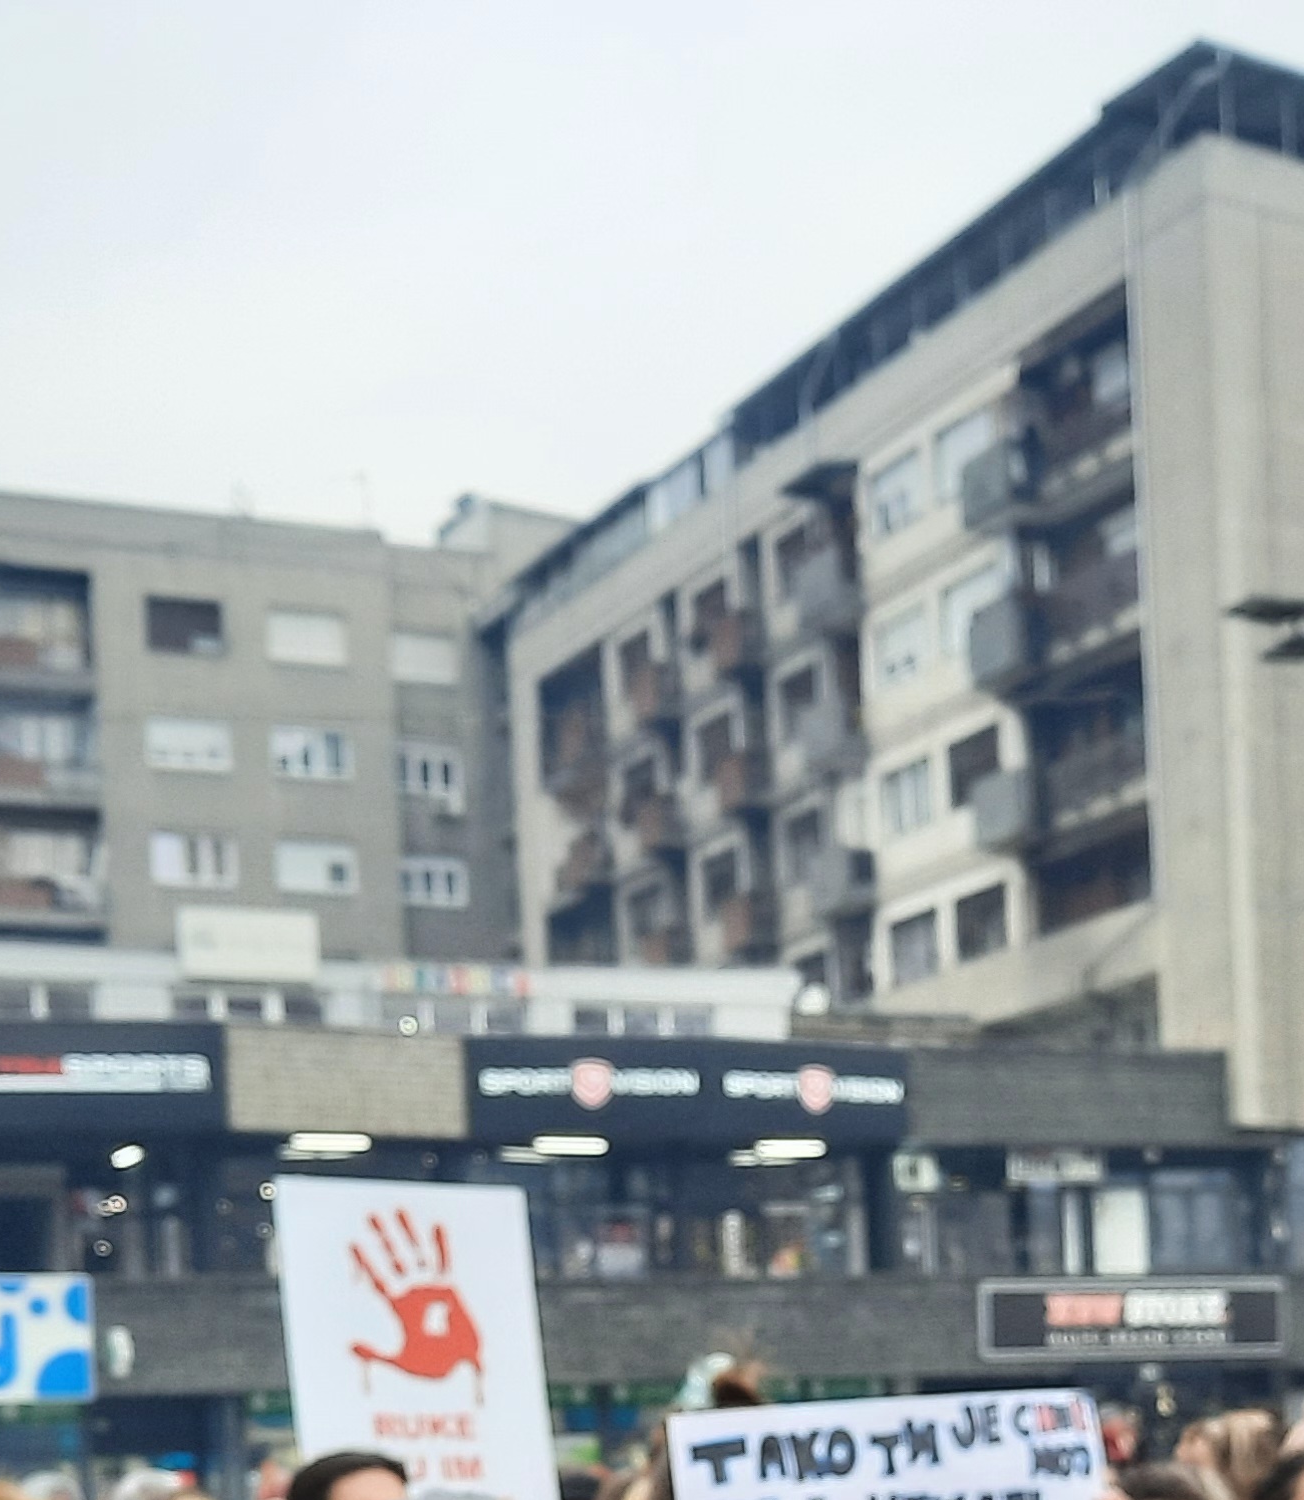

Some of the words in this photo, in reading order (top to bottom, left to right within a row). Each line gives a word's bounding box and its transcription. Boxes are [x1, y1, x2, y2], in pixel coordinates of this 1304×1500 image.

[478, 1066, 573, 1097] SPORT
[608, 1067, 700, 1096] VISION
[373, 1412, 472, 1440] RUKE
[692, 1430, 856, 1484] ТАКО
